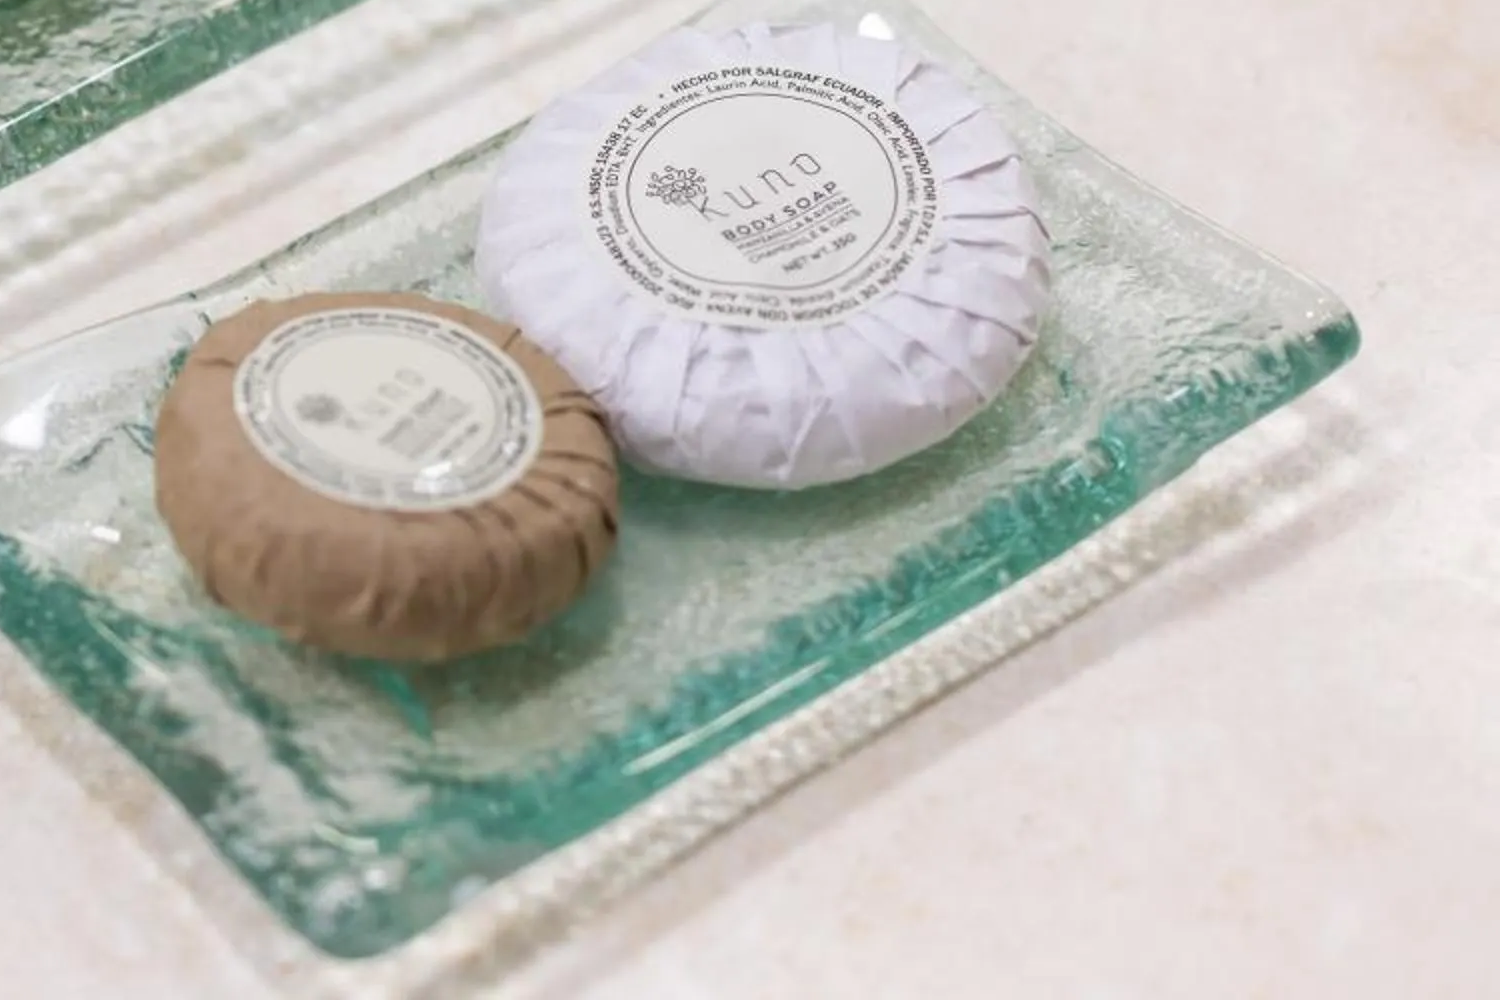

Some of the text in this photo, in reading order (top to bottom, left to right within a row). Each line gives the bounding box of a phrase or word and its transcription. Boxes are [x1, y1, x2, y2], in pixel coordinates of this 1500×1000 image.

[671, 72, 718, 93] HECHO
[721, 67, 752, 78] POR
[756, 67, 822, 83] SALGRAF
[823, 78, 884, 109] ECUADOR
[887, 112, 932, 175] IMPORTADO
[922, 177, 937, 202] POR
[721, 181, 838, 243] BODY SOAP
